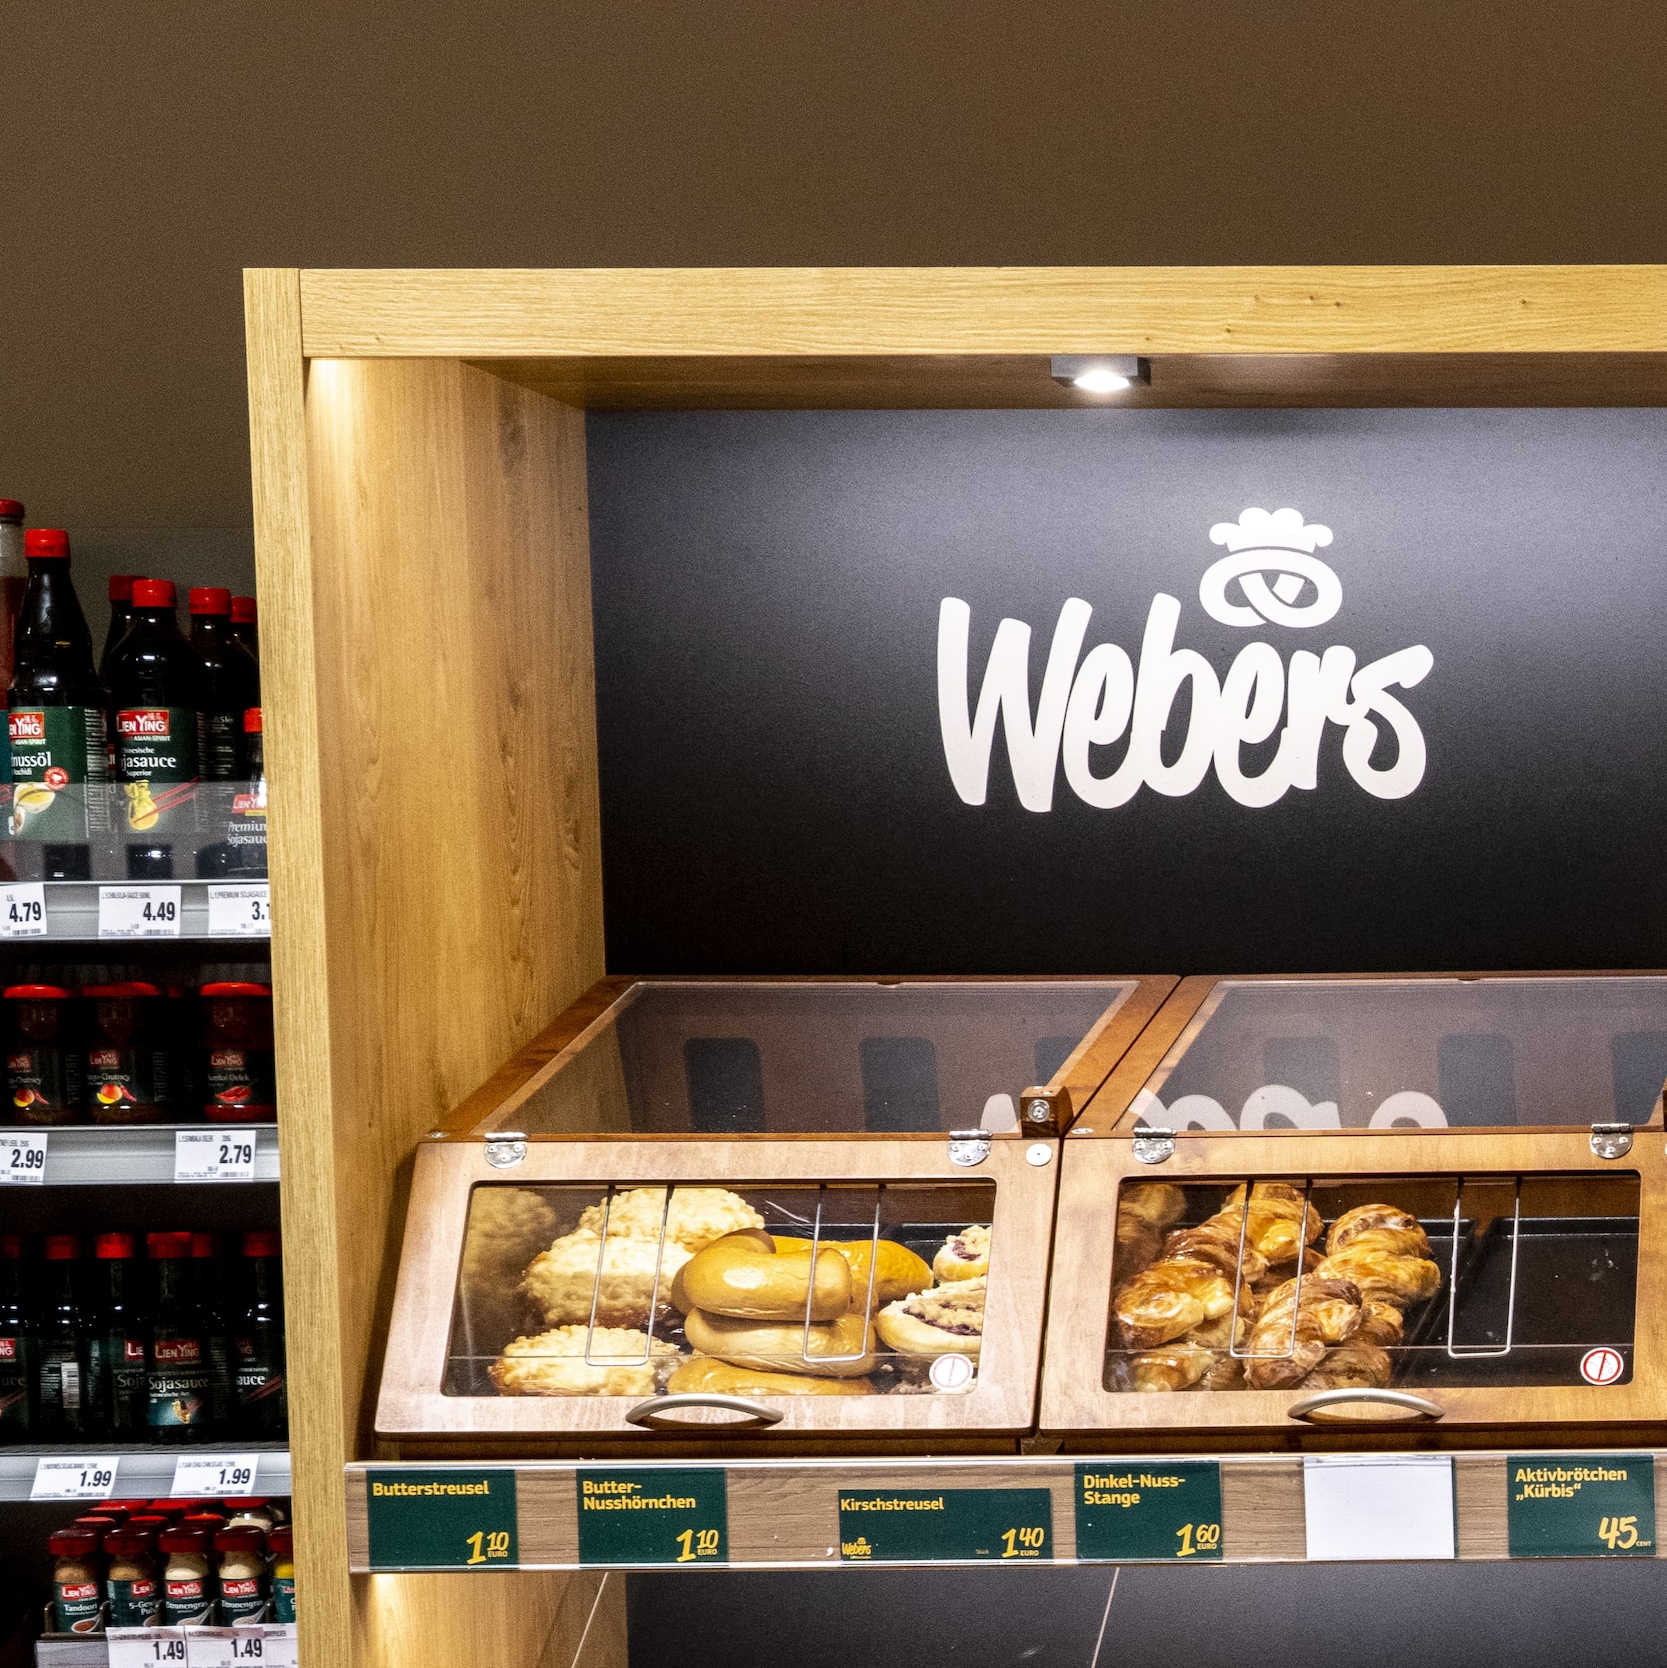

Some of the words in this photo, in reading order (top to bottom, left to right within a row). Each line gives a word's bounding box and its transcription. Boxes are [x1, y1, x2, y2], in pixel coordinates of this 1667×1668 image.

[937, 592, 1434, 813] Webers
[9, 901, 42, 923] 4.79
[142, 902, 176, 921] 4.49
[11, 1149, 44, 1168] 2.99
[219, 1145, 252, 1164] 2.79
[79, 1470, 112, 1487] 1.99
[218, 1468, 251, 1485] 1.99
[1084, 1474, 1185, 1488] Dinkel-Nuss-
[1516, 1467, 1627, 1482] Aktivbrötchen
[373, 1481, 489, 1496] Butterstreusel
[583, 1481, 641, 1496] Butter-
[584, 1494, 696, 1510] Nusshörnchen
[841, 1497, 944, 1510] Kirschstreusel
[1084, 1491, 1140, 1507] Stange
[1599, 1516, 1639, 1549] 45
[153, 1640, 185, 1661] 1.49
[230, 1639, 262, 1659] 1.49
